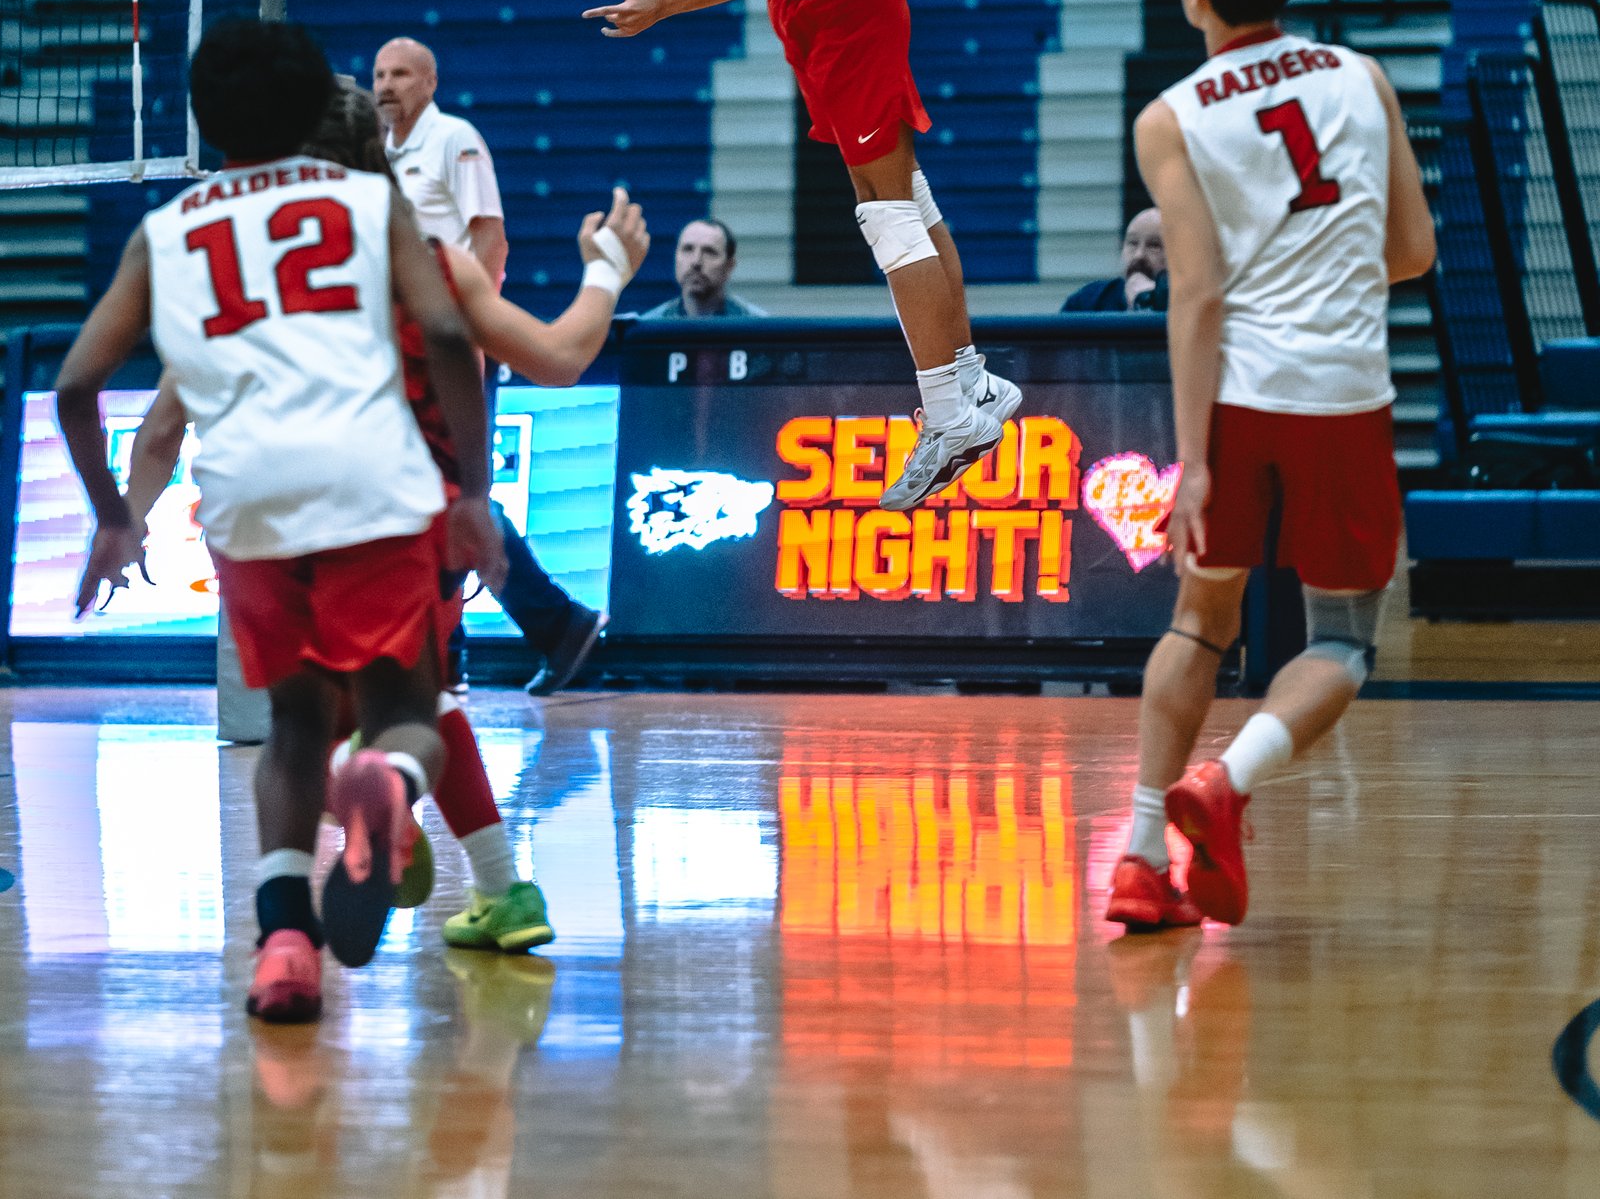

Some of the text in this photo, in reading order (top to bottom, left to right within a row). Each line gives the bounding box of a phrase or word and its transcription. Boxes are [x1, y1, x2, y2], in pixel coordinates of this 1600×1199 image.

[1195, 49, 1343, 108] RAIDERS
[1256, 97, 1342, 214] 1
[185, 197, 360, 338] 12
[668, 350, 748, 383] P B
[775, 509, 1072, 603] NIGHT!
